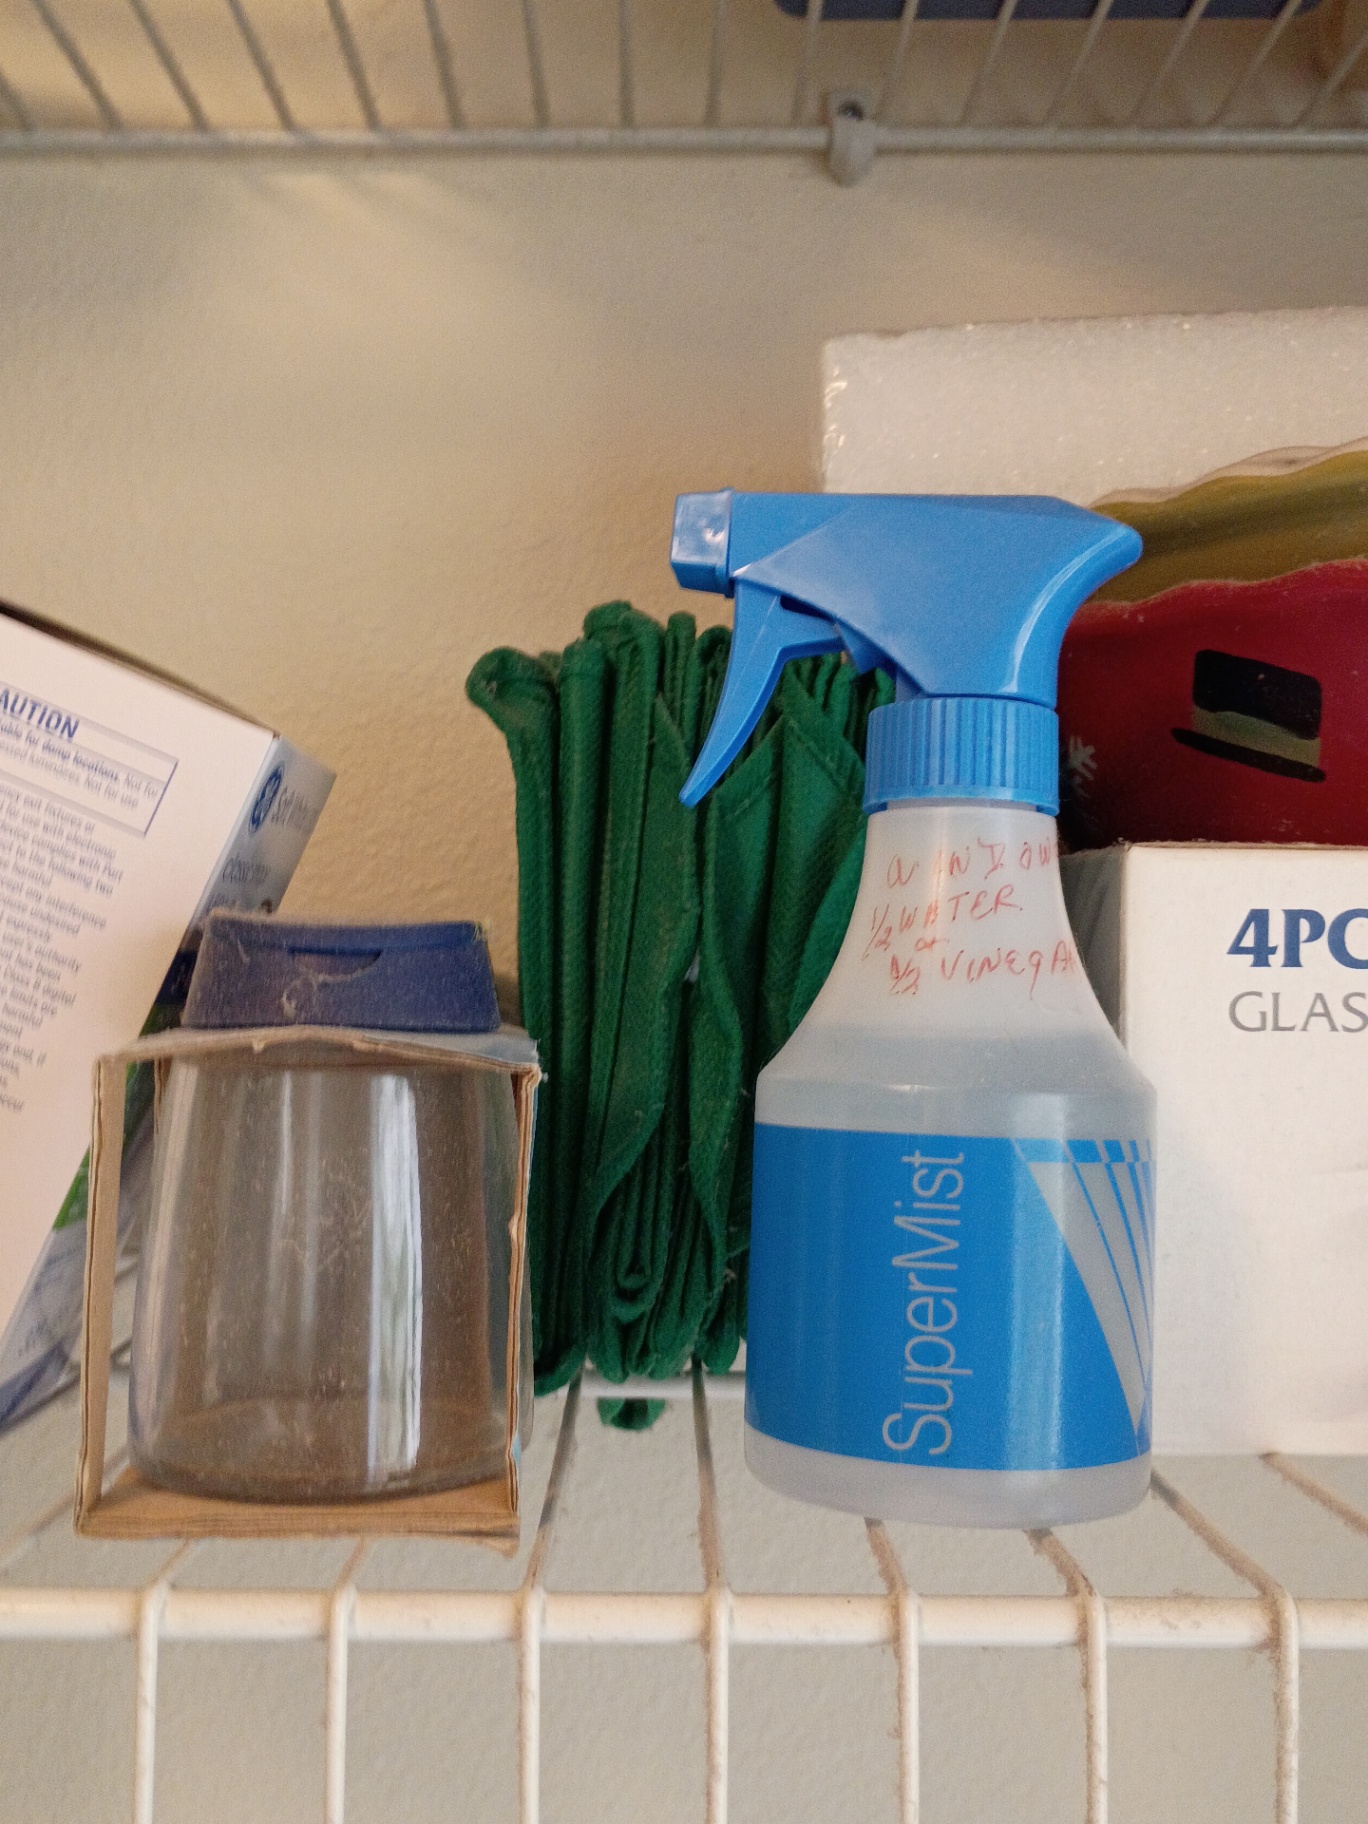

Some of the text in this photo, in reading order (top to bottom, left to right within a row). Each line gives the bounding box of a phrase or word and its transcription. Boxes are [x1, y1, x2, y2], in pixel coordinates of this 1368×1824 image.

[122, 771, 144, 791] Not
[41, 819, 66, 838] with
[77, 853, 102, 872] with
[1228, 990, 1368, 1033] GLAS
[882, 1150, 973, 1456] SuperMist
